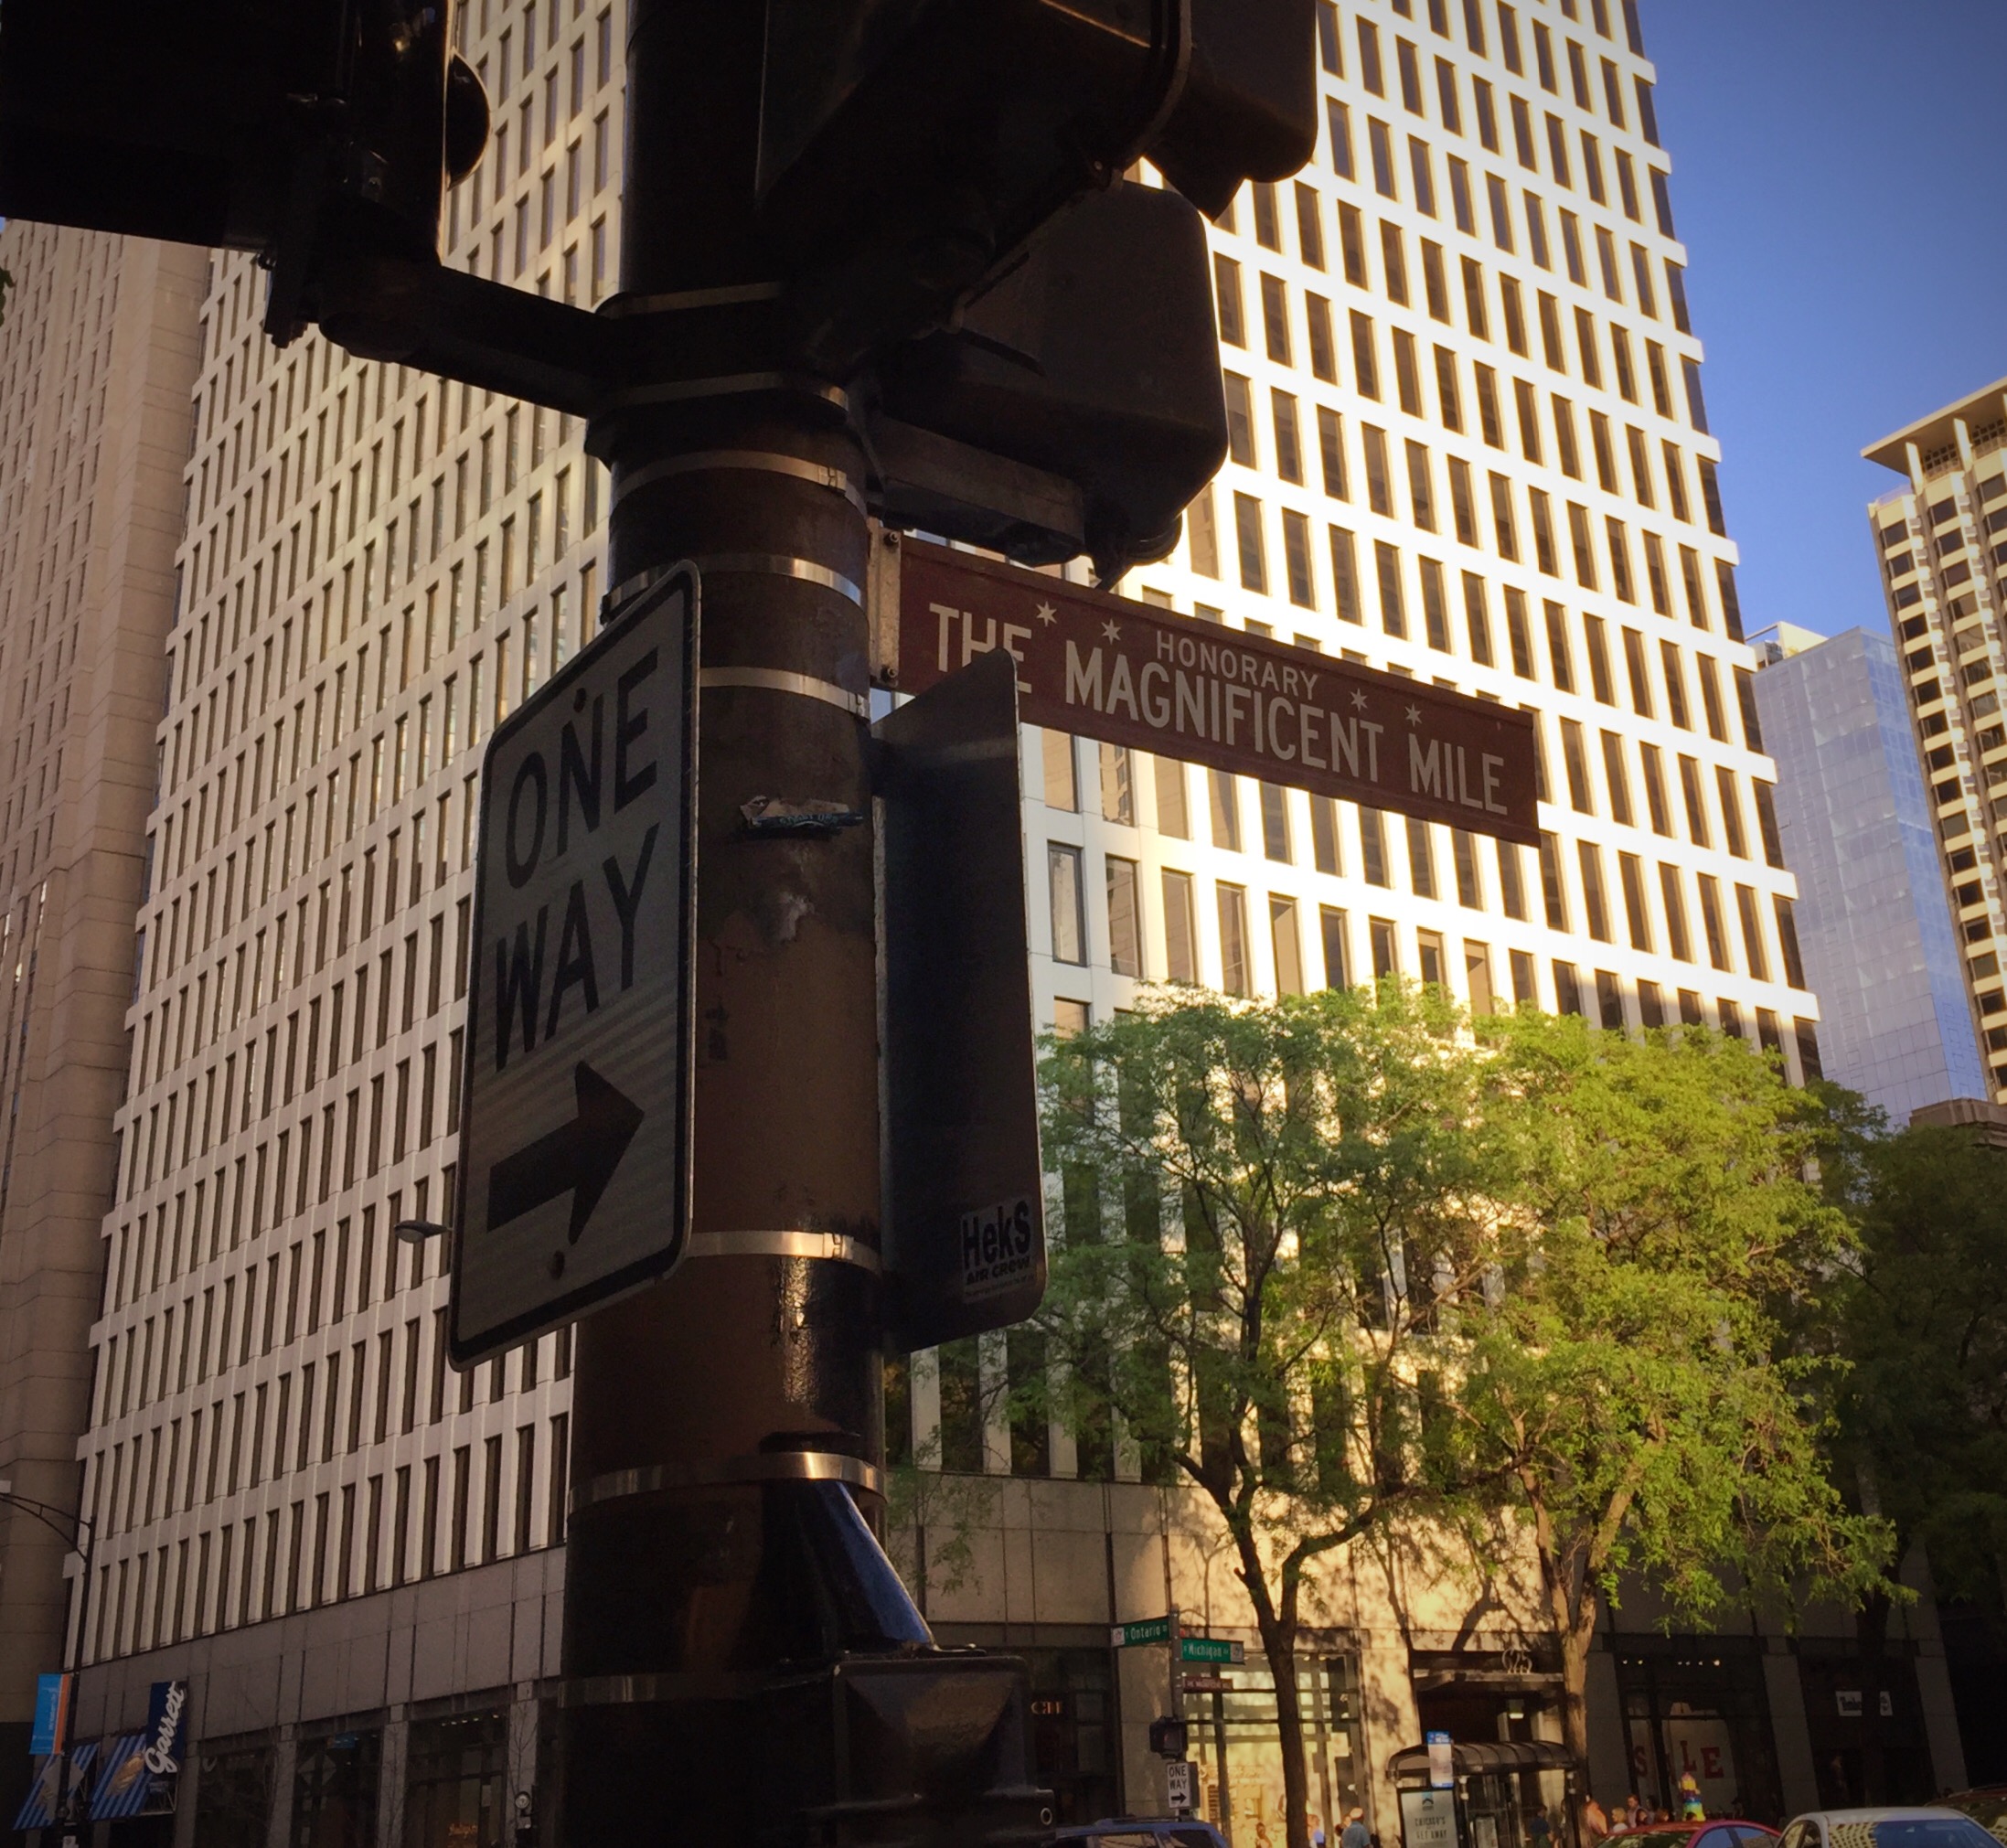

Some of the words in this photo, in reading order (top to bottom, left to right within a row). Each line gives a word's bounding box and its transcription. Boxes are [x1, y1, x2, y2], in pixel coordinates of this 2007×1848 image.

[1156, 630, 1319, 701] HONORARY
[1064, 639, 1385, 783] MAGNIFICENT
[1407, 732, 1509, 816] MILE
[505, 646, 659, 889] ONE
[496, 821, 659, 1072] WAY
[966, 1268, 988, 1286] AIR
[1130, 1625, 1161, 1640] Ontario
[1189, 1643, 1222, 1660] Michigan
[1500, 1646, 1533, 1674] 625
[144, 1680, 186, 1774] Garrett
[1169, 1765, 1187, 1777] ONE
[1634, 1740, 1724, 1779] SLE
[1169, 1779, 1188, 1789] WAY
